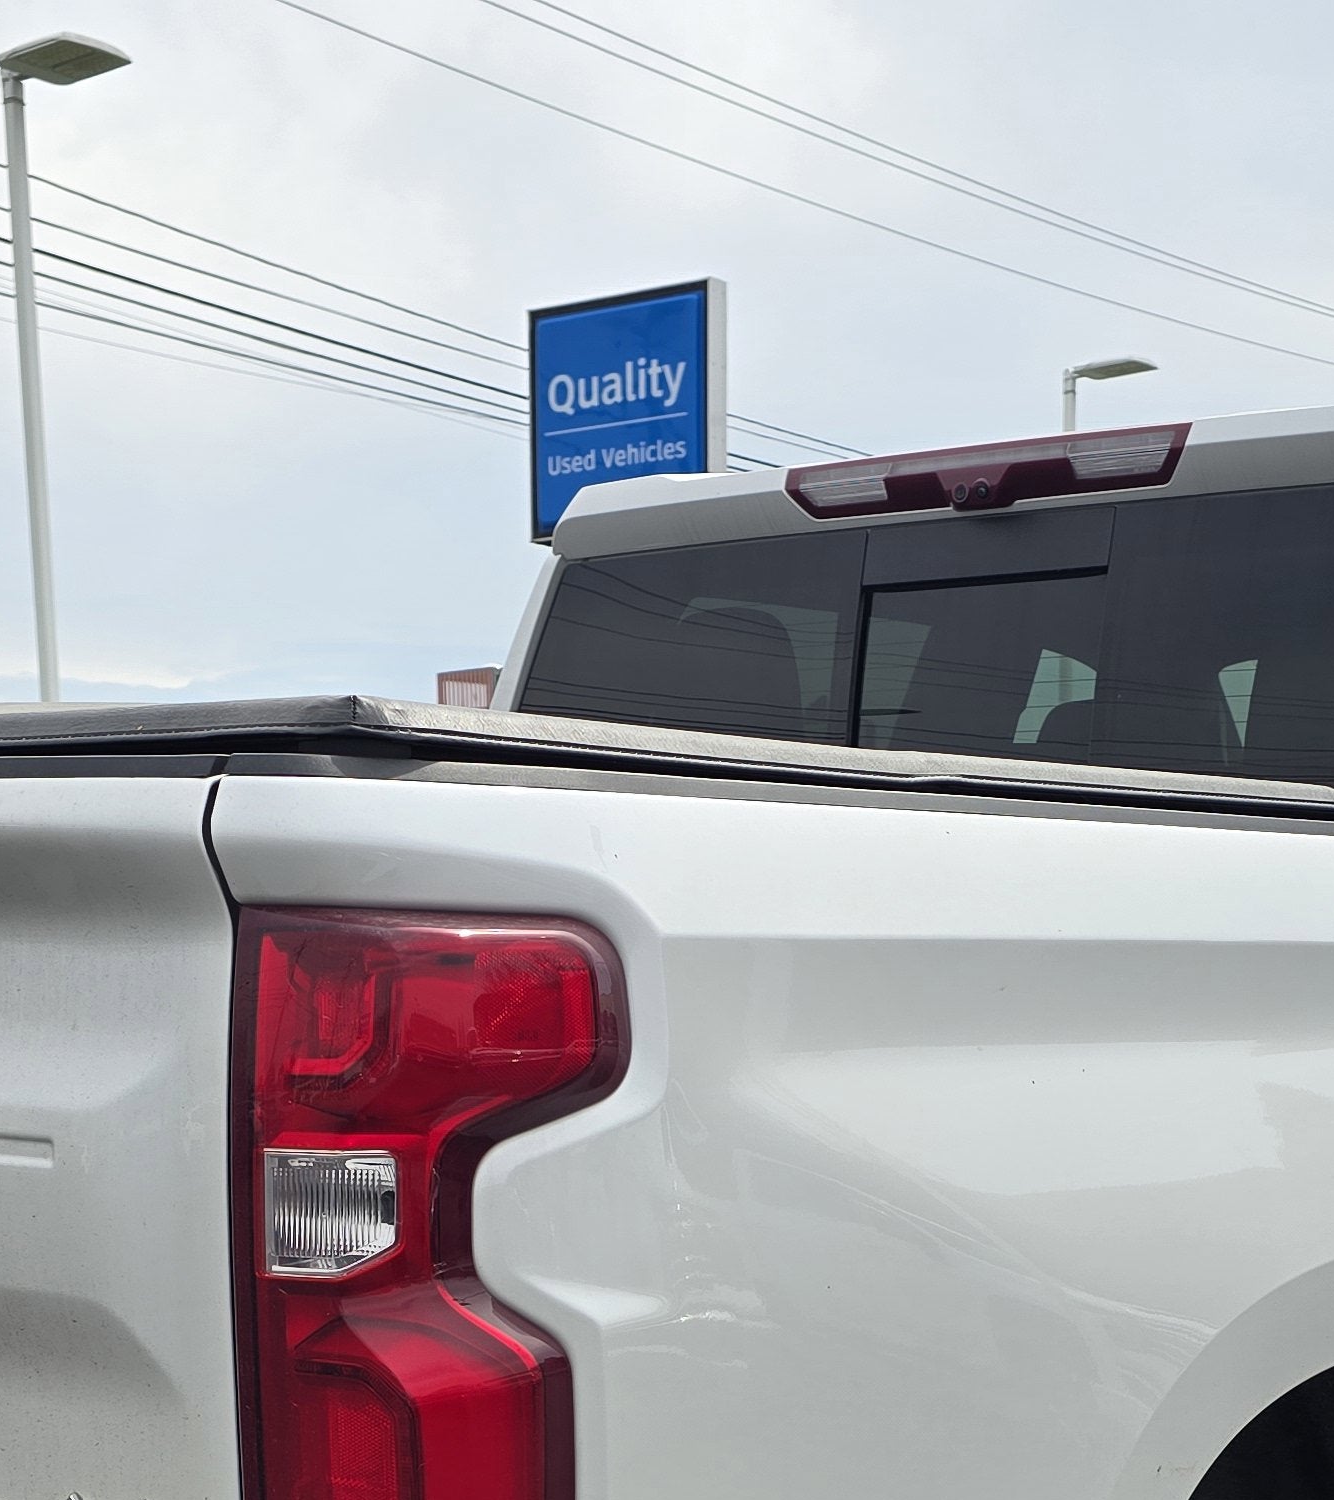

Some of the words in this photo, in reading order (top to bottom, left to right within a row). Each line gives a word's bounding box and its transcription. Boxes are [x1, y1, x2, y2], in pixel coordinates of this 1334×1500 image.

[547, 357, 686, 415] Quality
[548, 449, 596, 476] Used
[602, 440, 687, 468] Vehicles
